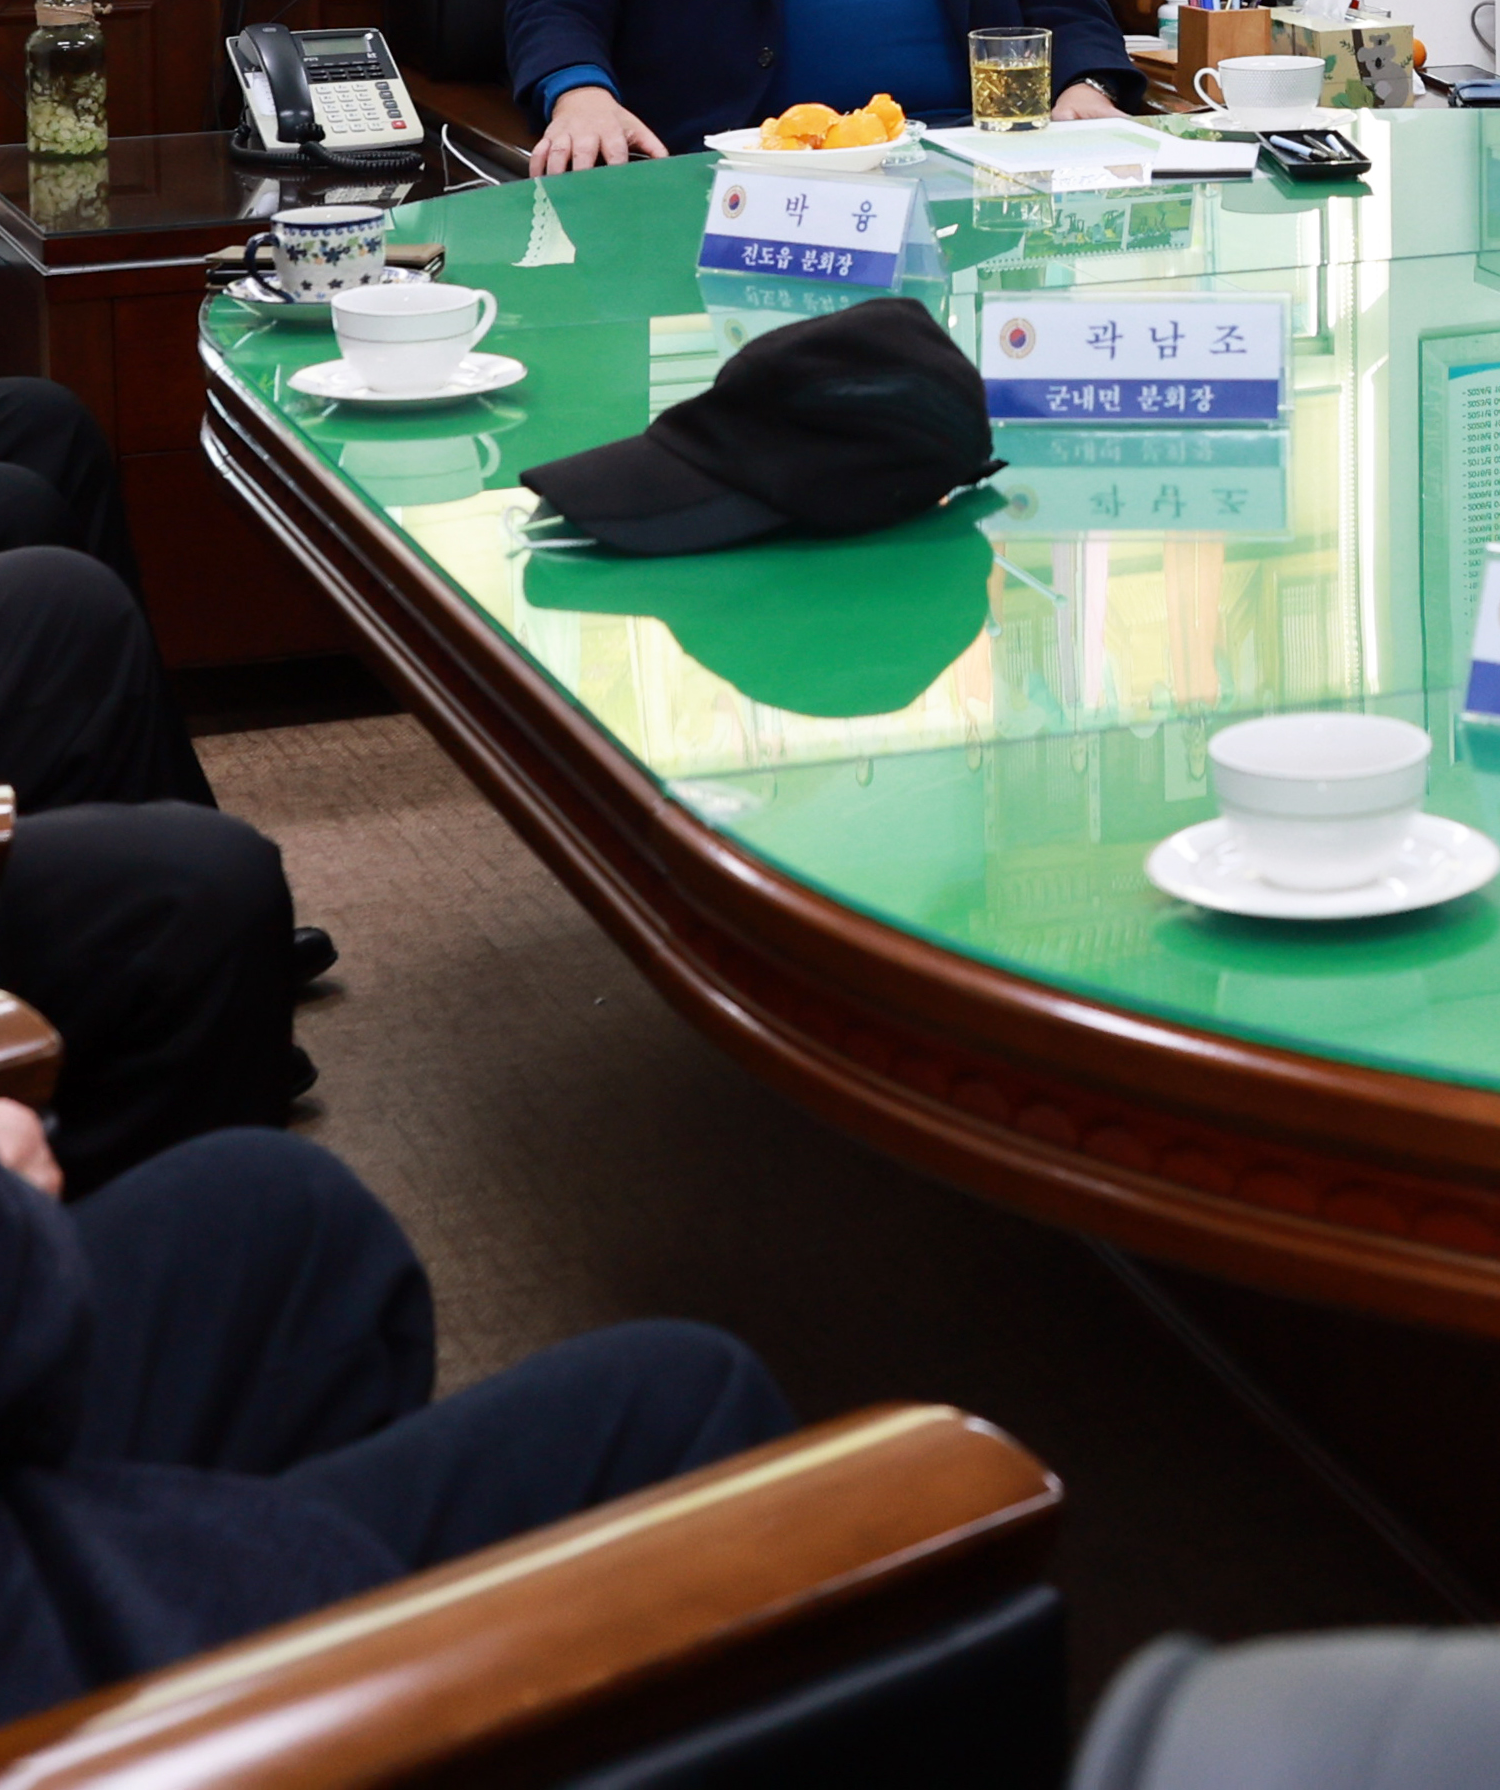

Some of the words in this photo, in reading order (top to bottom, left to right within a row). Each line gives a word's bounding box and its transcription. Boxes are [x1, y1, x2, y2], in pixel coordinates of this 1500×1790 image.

[741, 244, 792, 272] 진도읍
[801, 251, 853, 277] 분회장
[1045, 384, 1121, 414] 군내면
[1138, 384, 1215, 414] 분회장
